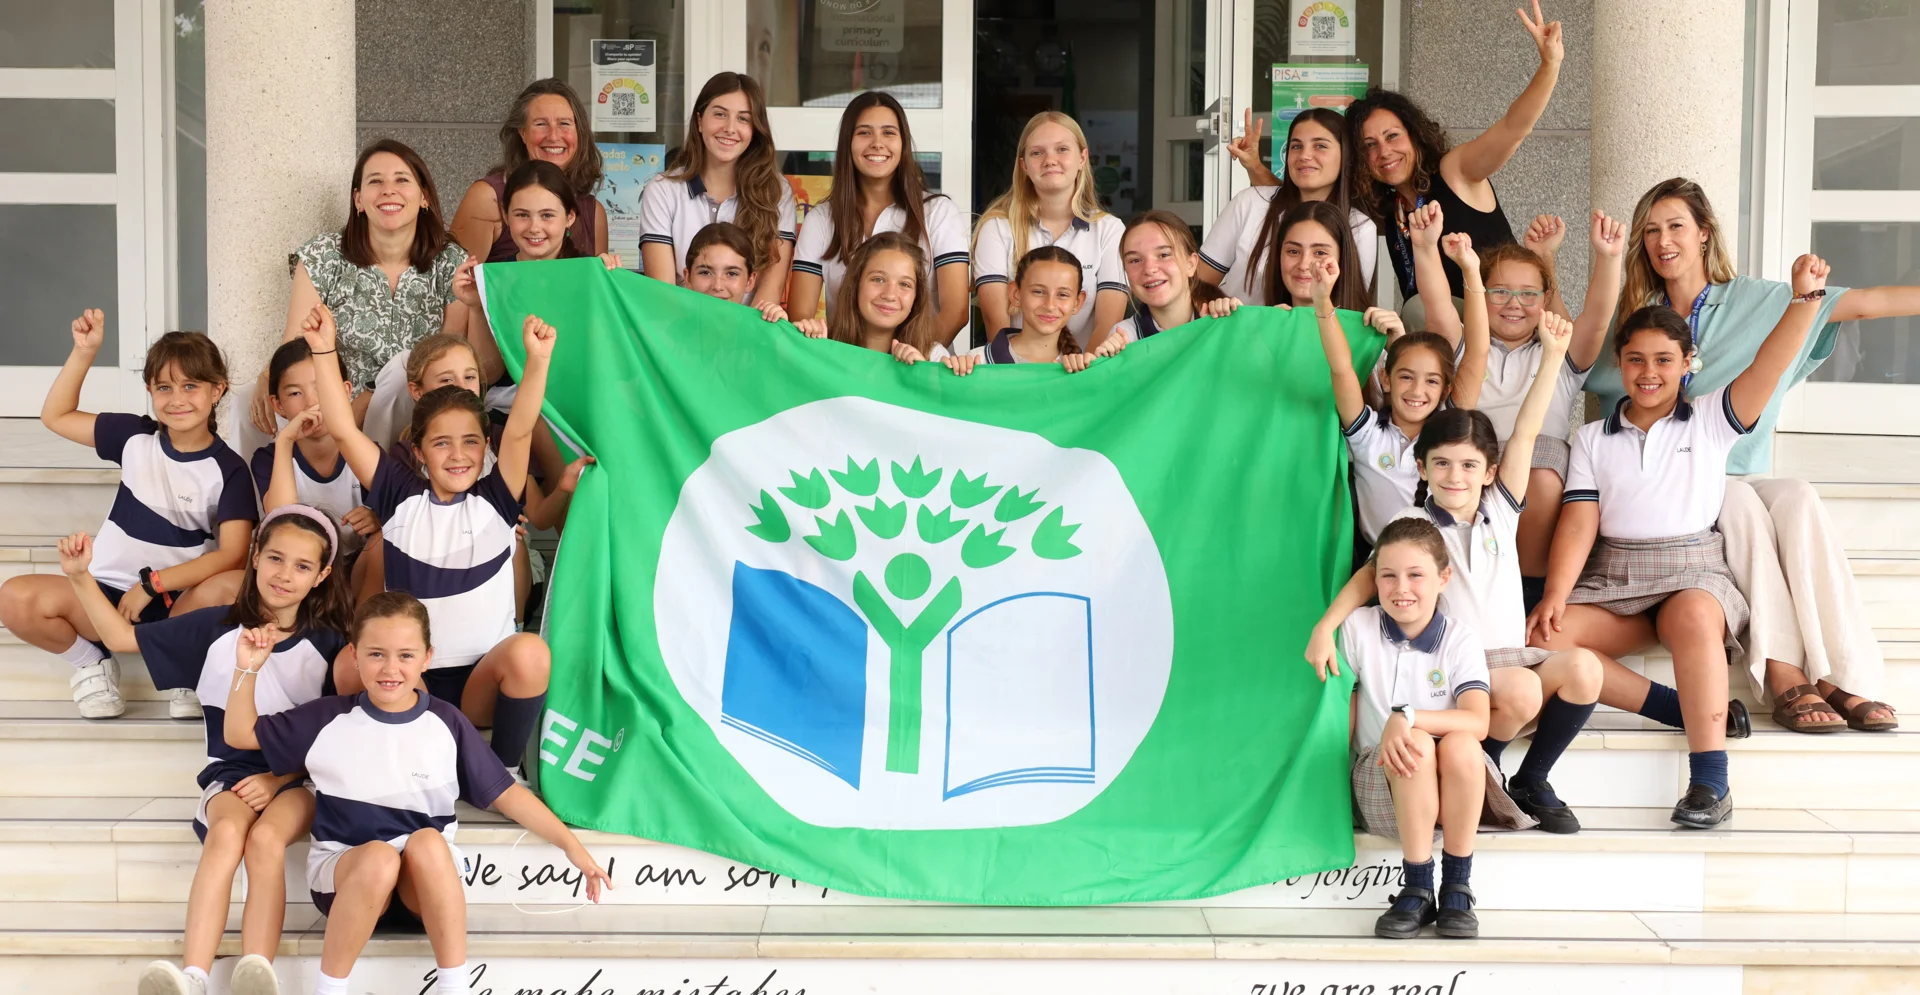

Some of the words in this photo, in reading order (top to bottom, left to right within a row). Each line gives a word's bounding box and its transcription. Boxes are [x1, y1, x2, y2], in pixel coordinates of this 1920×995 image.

[842, 26, 883, 37] primary
[835, 37, 889, 47] curriculum
[1274, 68, 1301, 81] PISA
[1431, 690, 1447, 698] LAUDE
[411, 771, 429, 780] LAUDE
[517, 863, 584, 898] say
[635, 863, 706, 887] am
